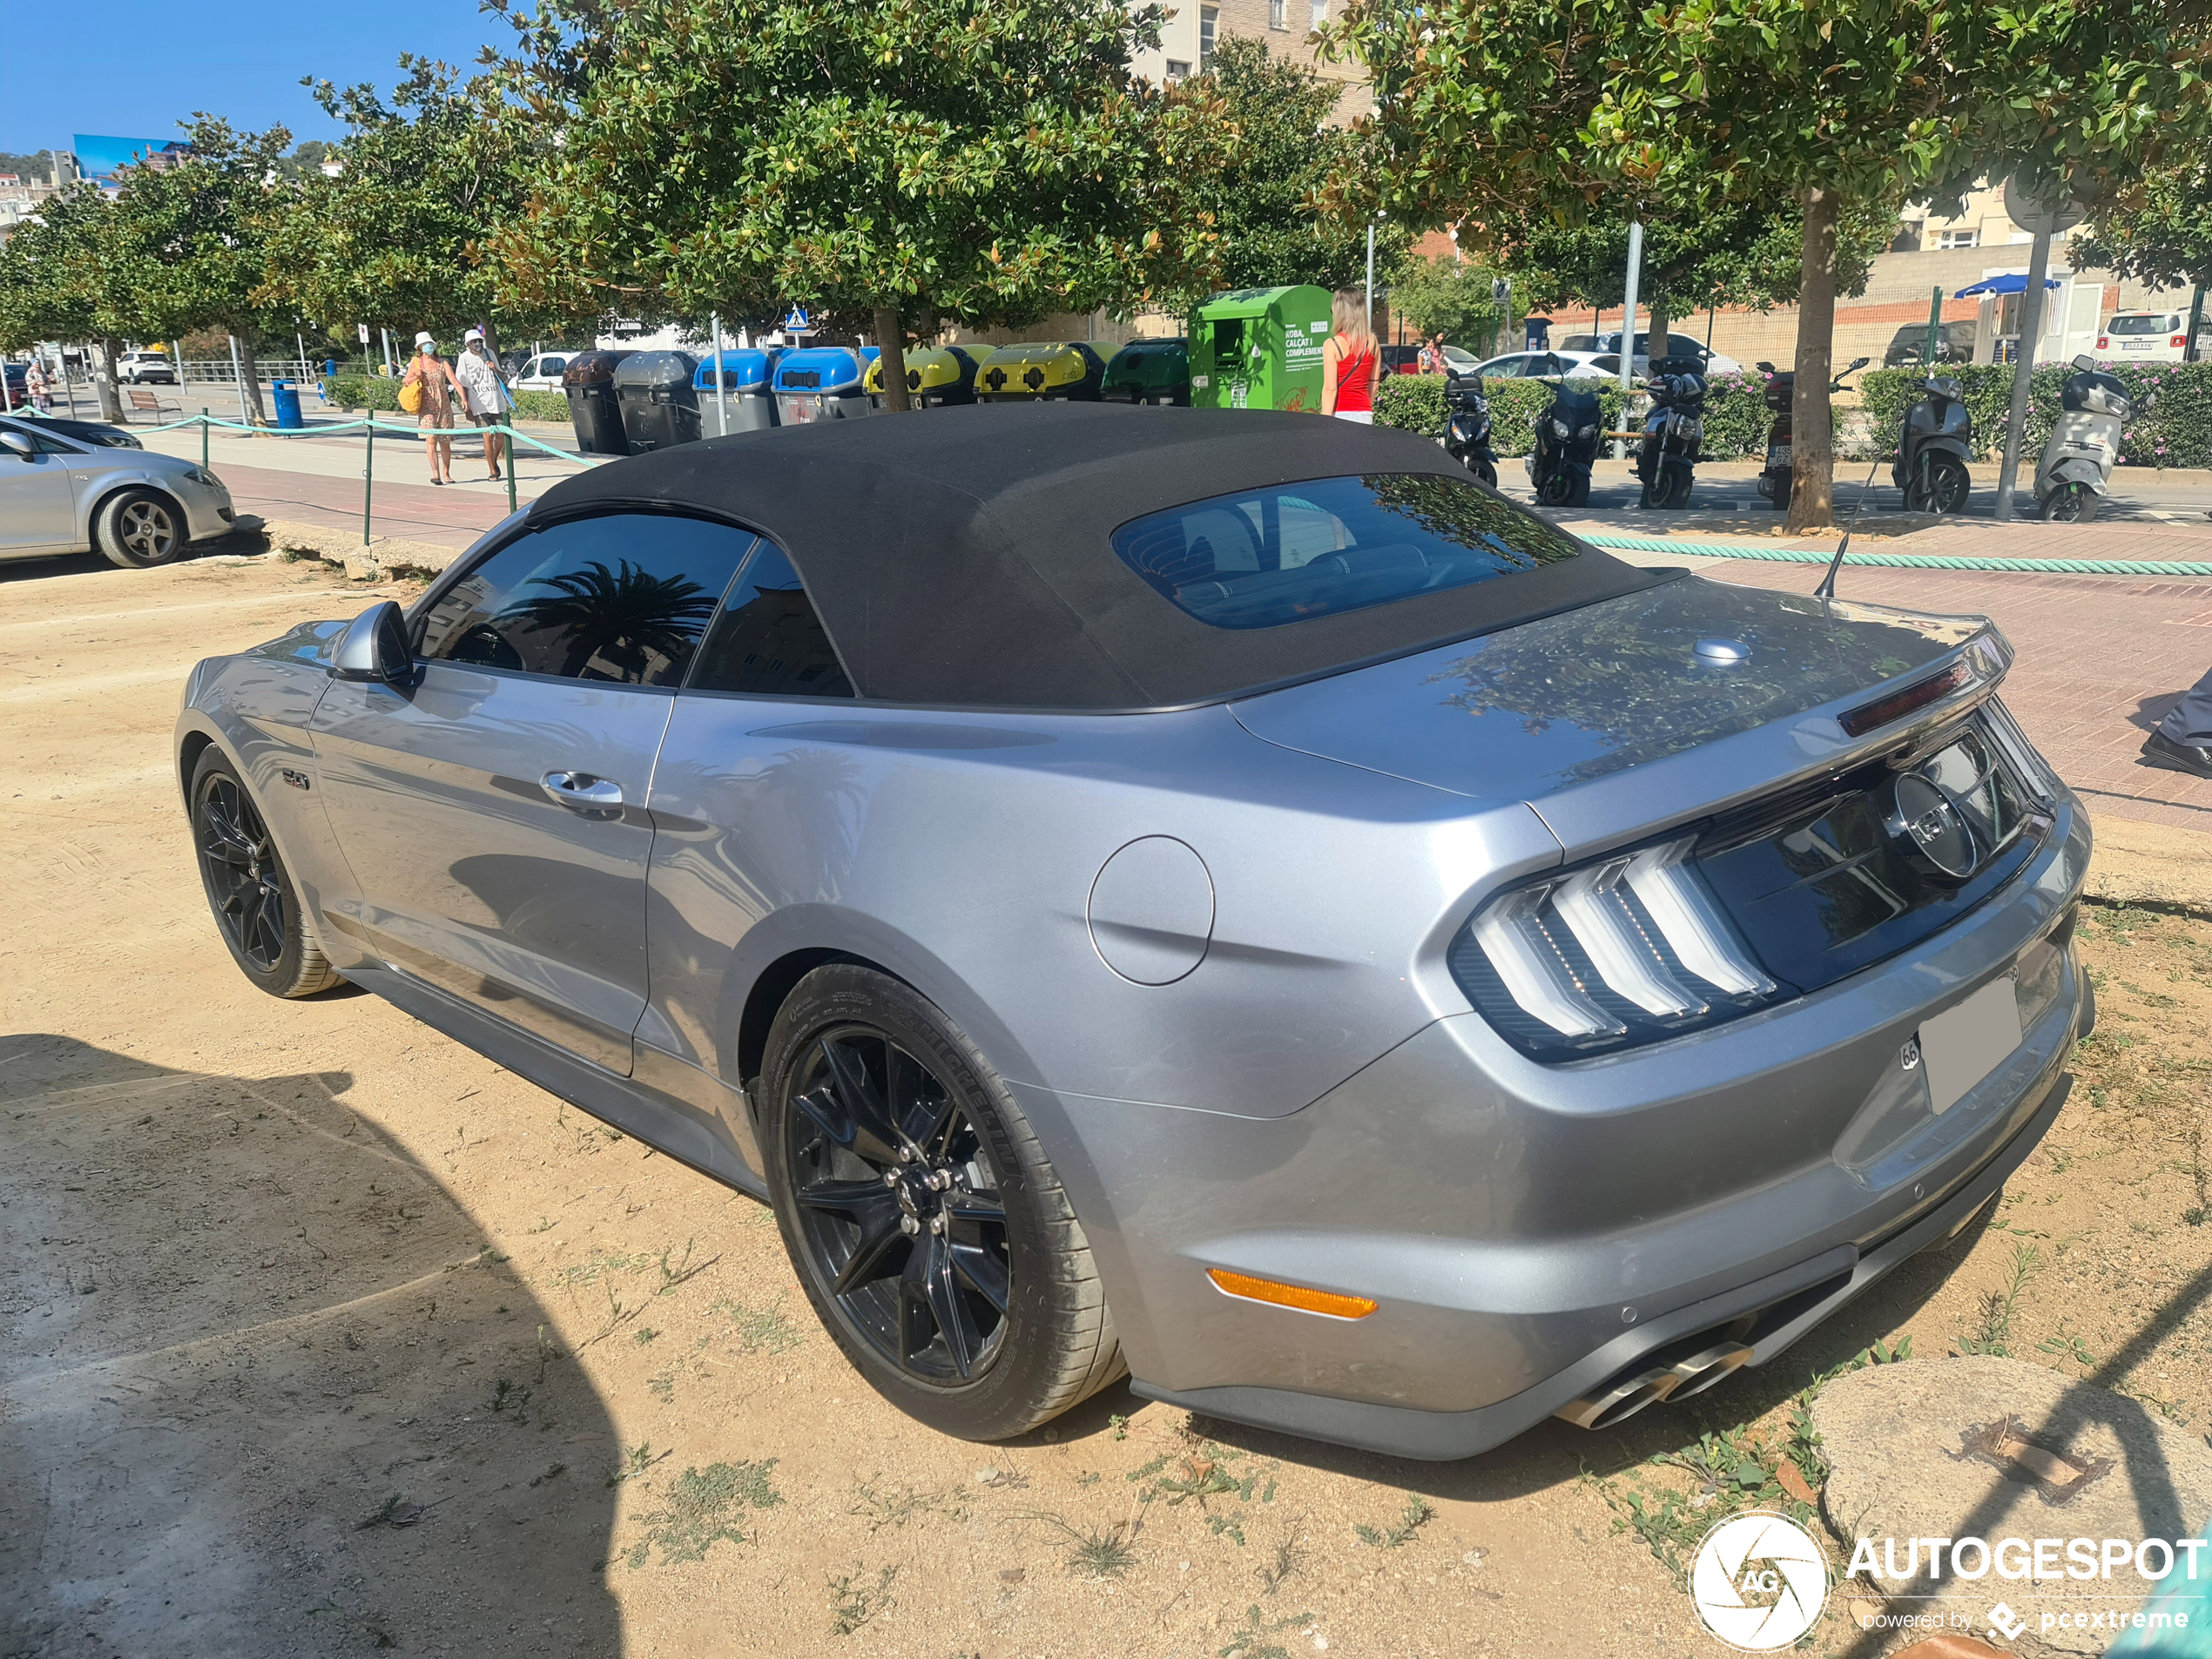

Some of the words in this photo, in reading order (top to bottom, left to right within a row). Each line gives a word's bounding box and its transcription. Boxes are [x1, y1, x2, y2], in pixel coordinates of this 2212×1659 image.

[1286, 329, 1305, 339] ROBA,
[1285, 338, 1309, 348] CALÇAT
[1903, 1043, 1917, 1066] 66
[916, 1022, 1020, 1170] MICHELIN
